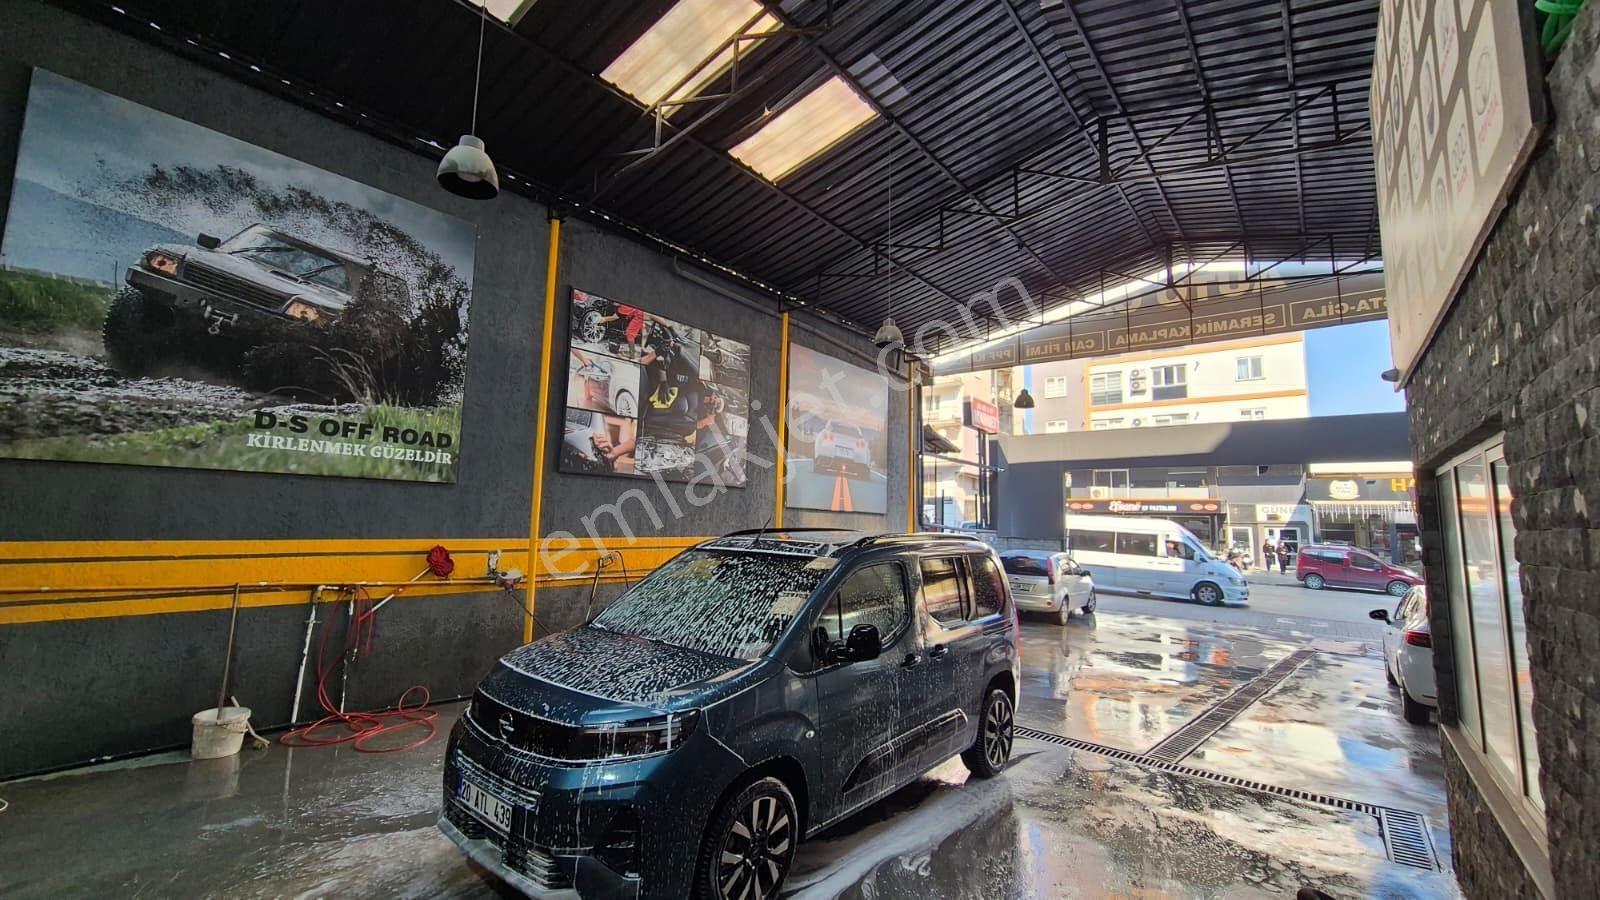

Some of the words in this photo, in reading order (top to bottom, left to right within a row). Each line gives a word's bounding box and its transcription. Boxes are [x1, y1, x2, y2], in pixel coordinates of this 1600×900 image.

[254, 411, 309, 433] D-S
[319, 418, 373, 440] OFF
[382, 426, 452, 448] ROAD
[246, 432, 366, 457] KİRLENMEK
[370, 445, 452, 465] GÜZELDİR
[461, 782, 471, 803] 20
[474, 790, 489, 816] ATL
[493, 801, 511, 828] 439
